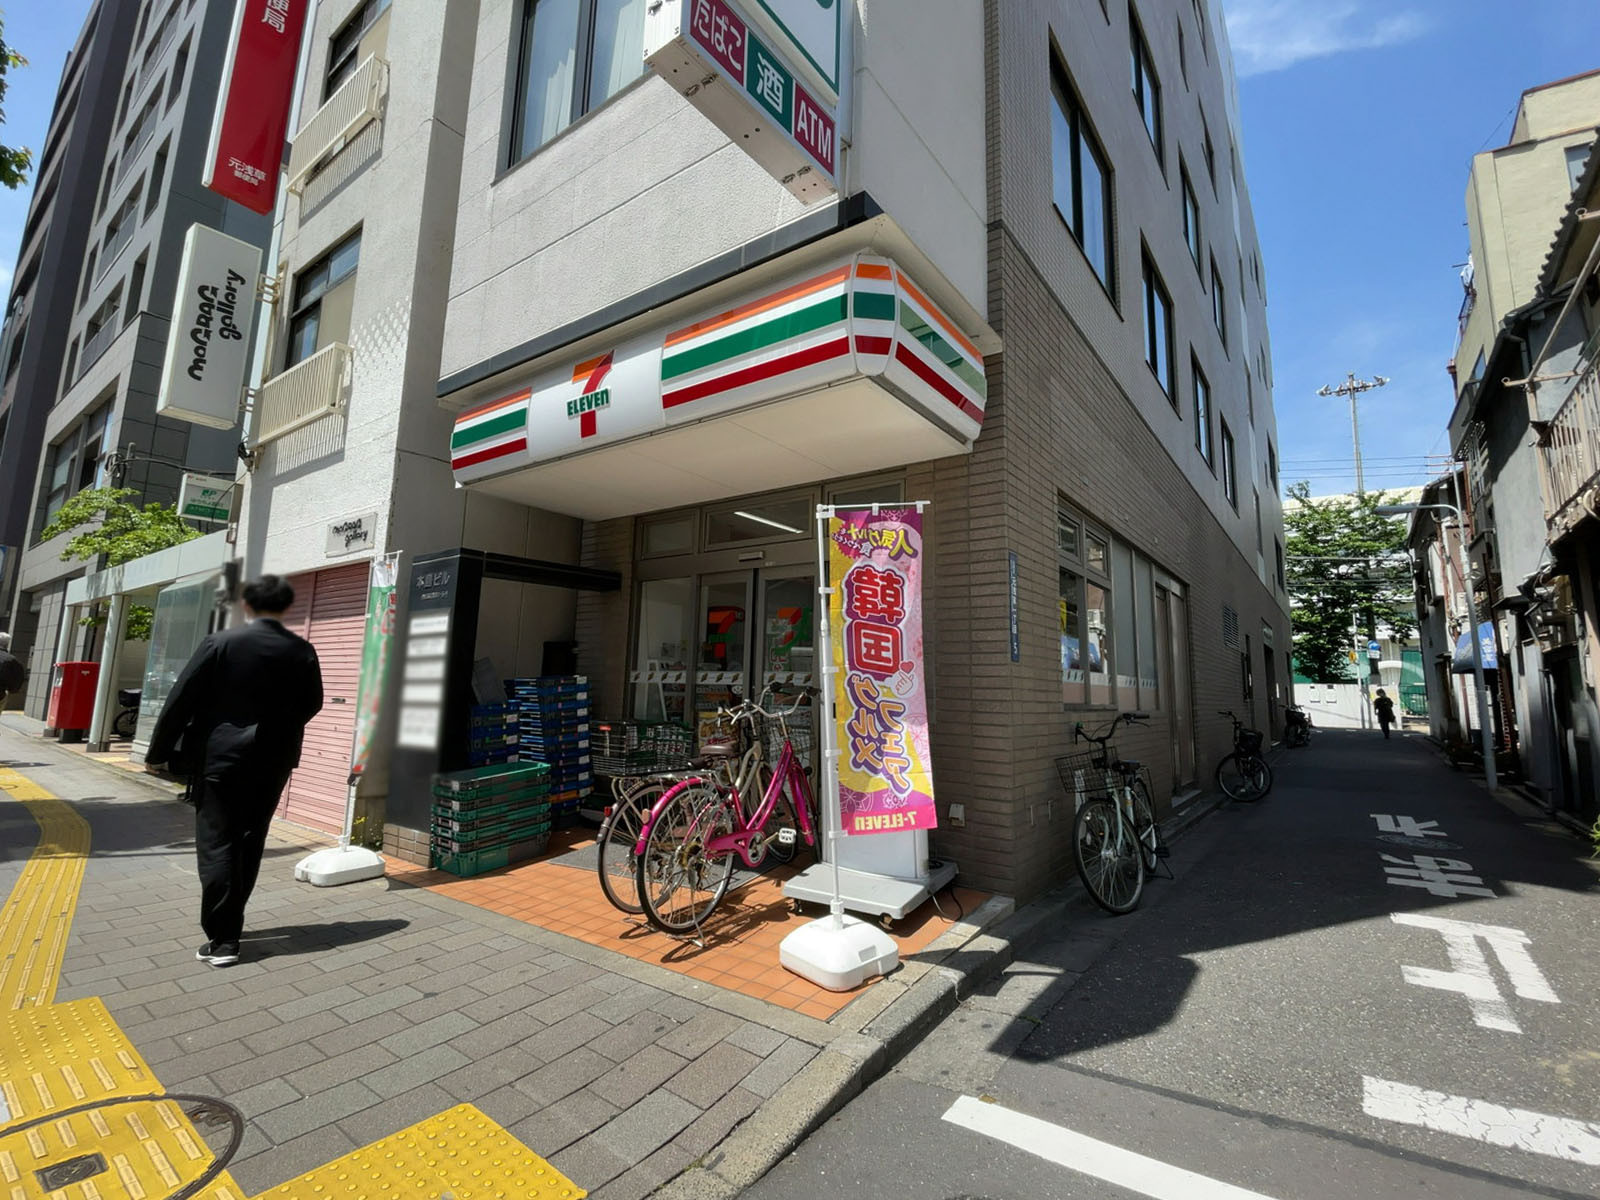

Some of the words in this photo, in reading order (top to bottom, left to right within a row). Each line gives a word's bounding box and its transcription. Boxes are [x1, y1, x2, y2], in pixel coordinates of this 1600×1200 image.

[693, 0, 742, 71] たばこ
[756, 52, 784, 115] 酒
[797, 100, 832, 164] ATM
[216, 268, 247, 341] gallery
[1369, 813, 1562, 1034] 止まれ
